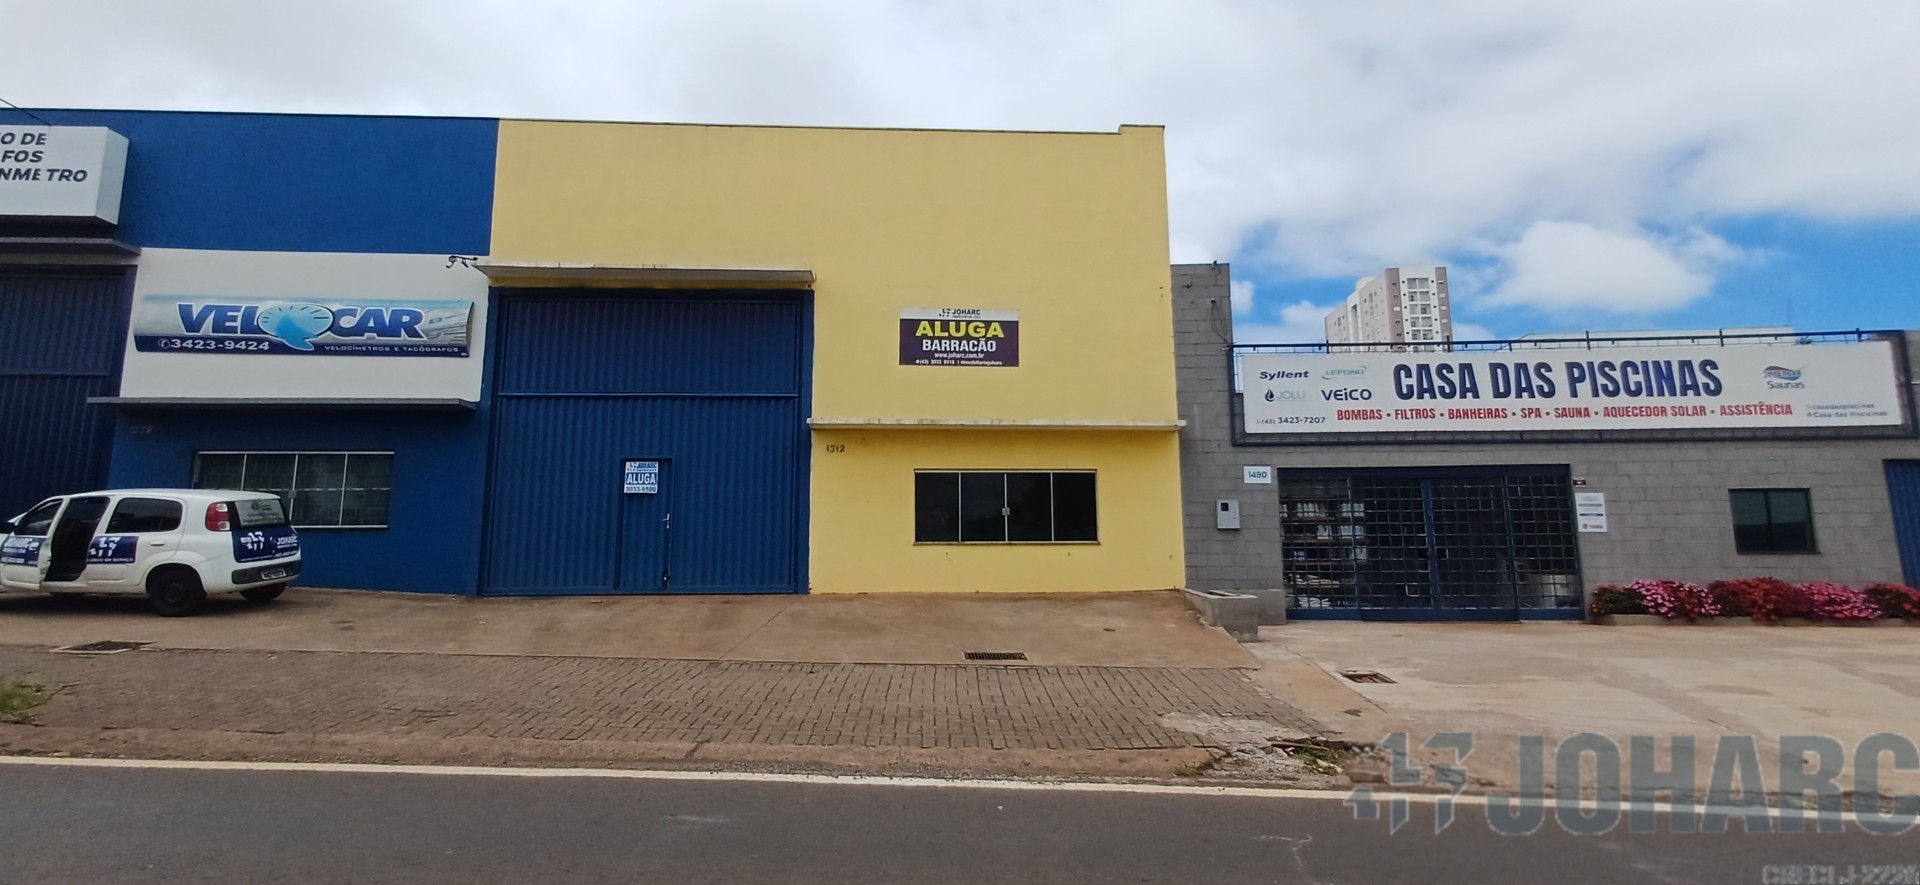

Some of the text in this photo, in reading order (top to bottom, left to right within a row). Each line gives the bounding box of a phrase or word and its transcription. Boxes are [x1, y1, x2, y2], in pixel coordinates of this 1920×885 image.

[20, 133, 47, 146] DE
[952, 308, 981, 316] JOHARC
[915, 320, 1005, 338] ALUGA
[170, 338, 270, 351] 3423-9424
[922, 338, 997, 352] BARRACÃO
[1259, 371, 1309, 381] Syllent
[1393, 359, 1723, 400] CASA DAS PISCINAS
[1767, 380, 1805, 389] Saunas
[1337, 401, 1793, 421] BOMBAS FILTROS BANHEIRAS SPA SAUNA AQUECEDOR SOLAR ASSISTÊNCIA
[1278, 416, 1326, 425] 3423-7207
[626, 473, 656, 484] ALUGA
